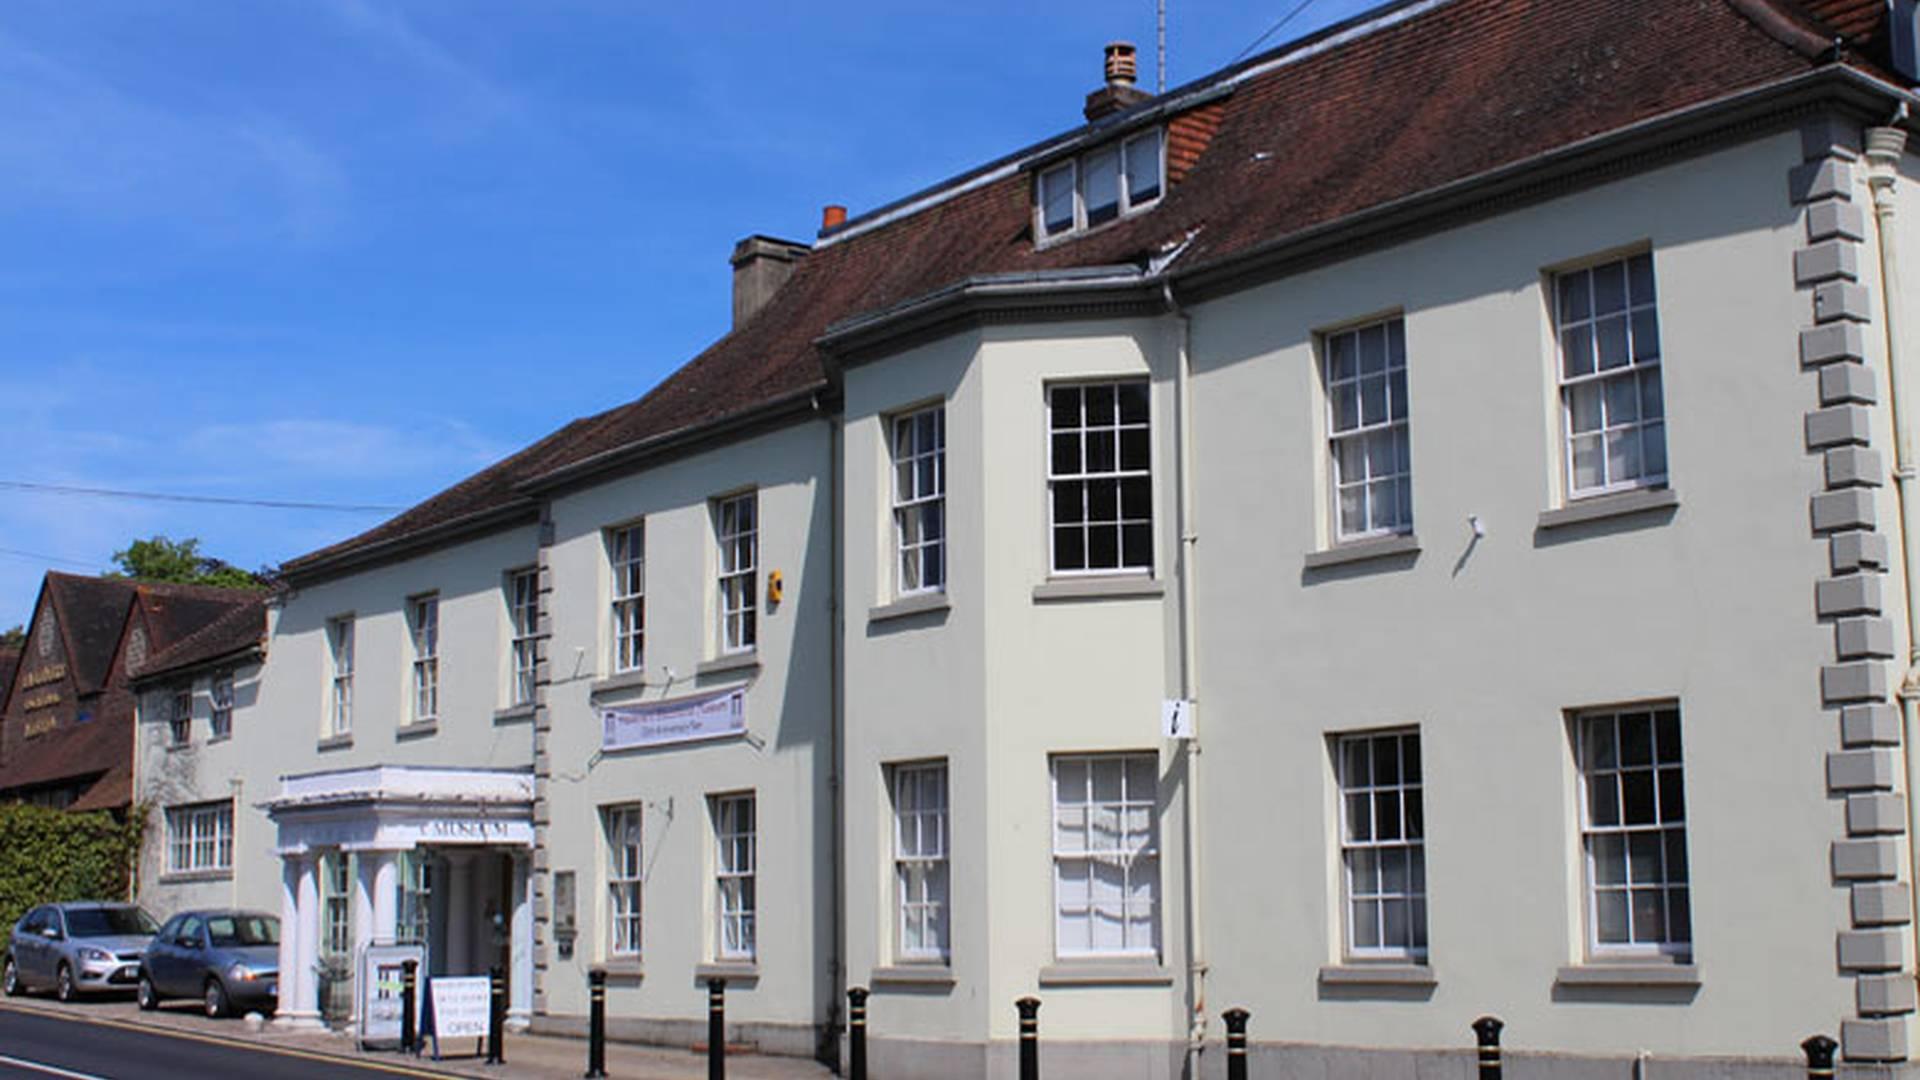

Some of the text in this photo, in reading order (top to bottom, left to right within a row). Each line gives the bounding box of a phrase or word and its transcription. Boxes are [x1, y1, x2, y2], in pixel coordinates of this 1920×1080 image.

[1171, 702, 1180, 735] i
[434, 821, 508, 837] MUSEUM
[448, 1021, 484, 1033] OPEN
